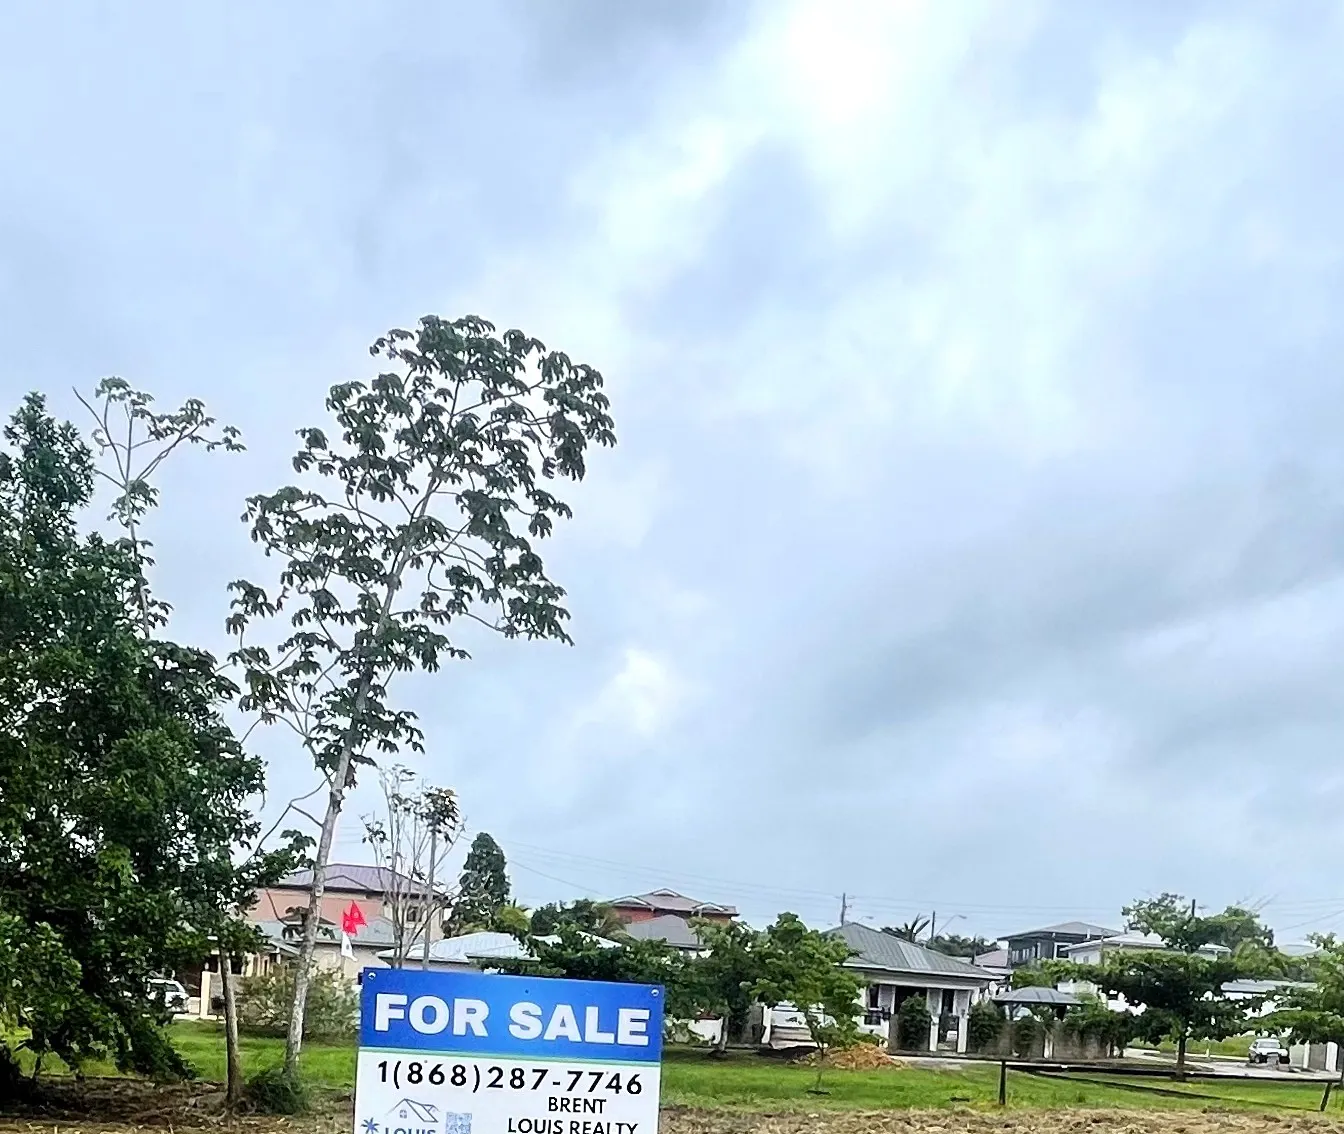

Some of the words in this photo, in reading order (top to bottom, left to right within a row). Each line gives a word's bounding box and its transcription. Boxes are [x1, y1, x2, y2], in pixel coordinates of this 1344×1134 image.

[374, 993, 490, 1037] FOR
[508, 1001, 651, 1046] SALE
[377, 1060, 642, 1095] 1(868)287-7746
[548, 1096, 607, 1114] BRENT
